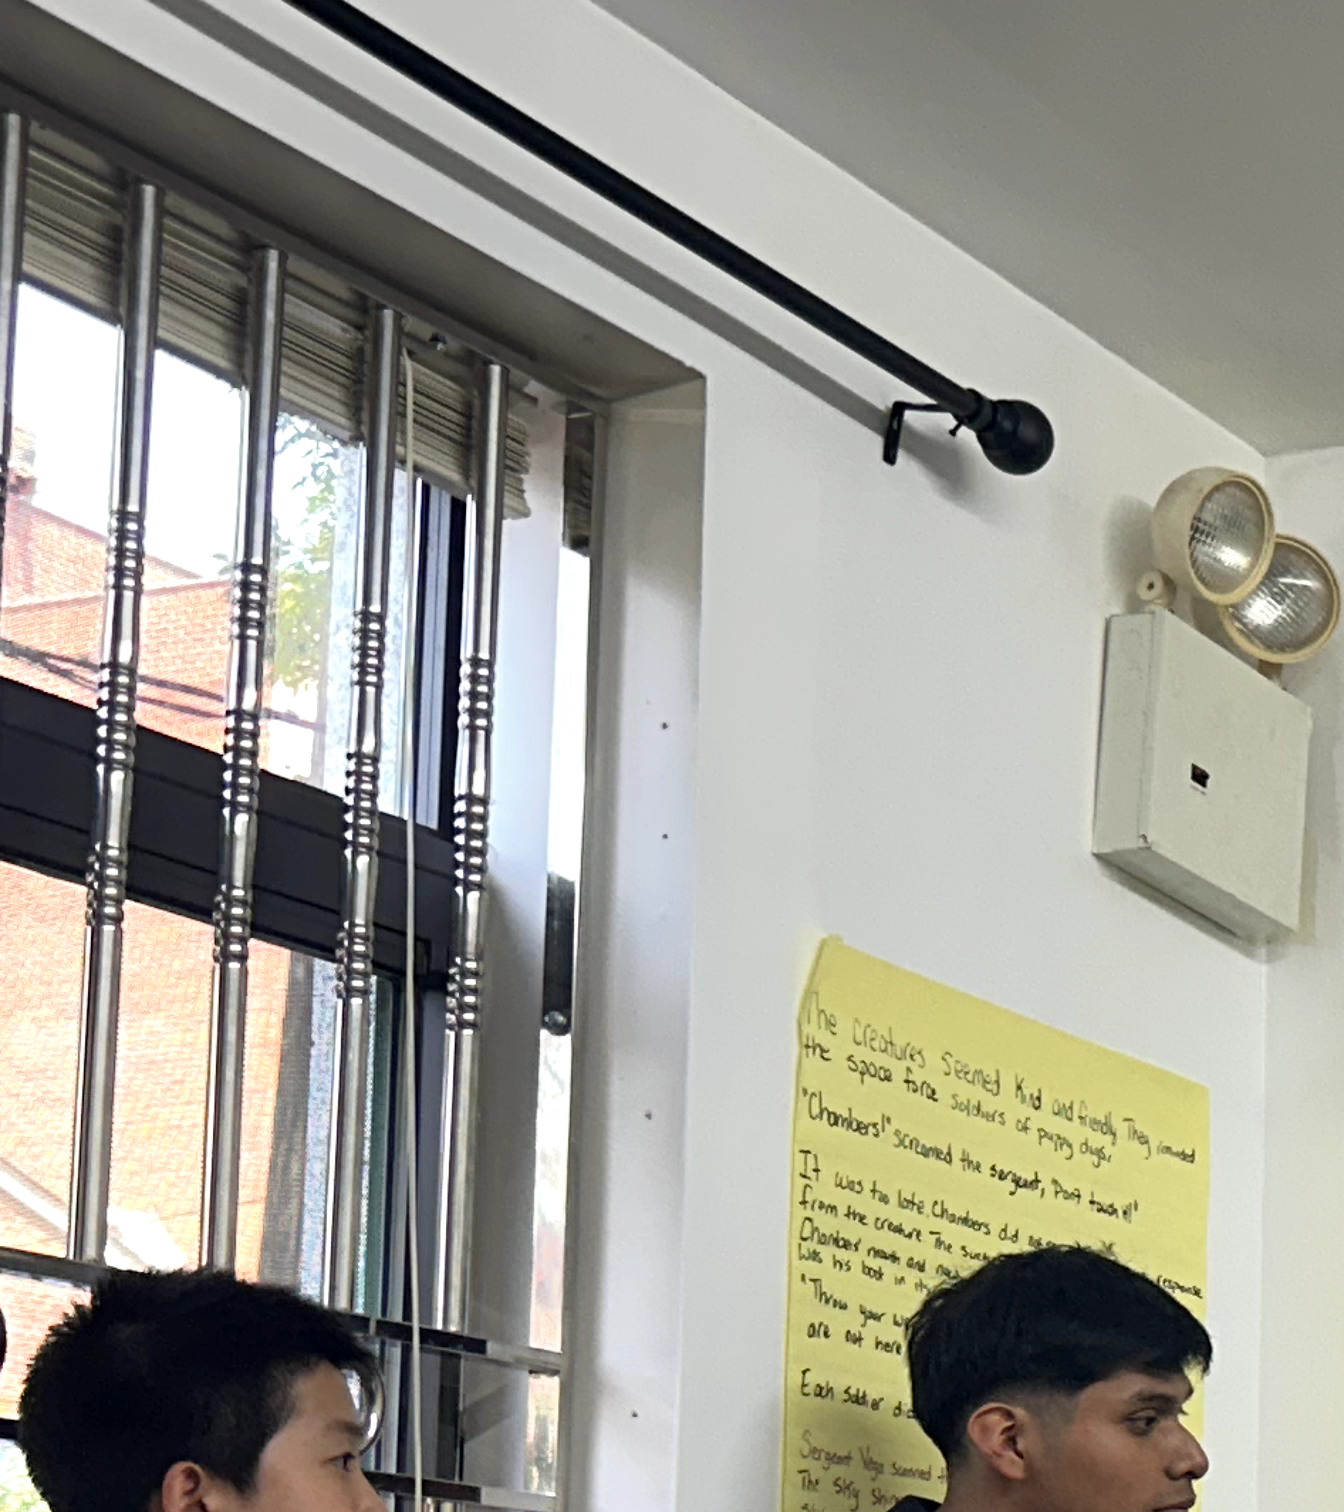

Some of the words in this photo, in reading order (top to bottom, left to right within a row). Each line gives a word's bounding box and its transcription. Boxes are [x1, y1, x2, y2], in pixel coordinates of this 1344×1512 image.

[806, 990, 838, 1036] The
[1052, 1098, 1073, 1122] and
[803, 1033, 832, 1061] the
[846, 1053, 893, 1085] space
[903, 1066, 938, 1102] force
[1015, 1116, 1031, 1135] of
[893, 1128, 952, 1167] screamed
[959, 1148, 982, 1174] the
[799, 1150, 821, 1181] It
[870, 1179, 890, 1205] too
[931, 1200, 991, 1235] Chambers
[998, 1222, 1019, 1245] did
[799, 1183, 838, 1217] from
[844, 1205, 868, 1226] the
[832, 1254, 852, 1273] his
[894, 1274, 906, 1287] in
[906, 1256, 926, 1274] and
[807, 1321, 831, 1340] are
[845, 1329, 864, 1348] not
[874, 1335, 902, 1356] here
[801, 1367, 835, 1402] Each
[797, 1469, 820, 1493] The
